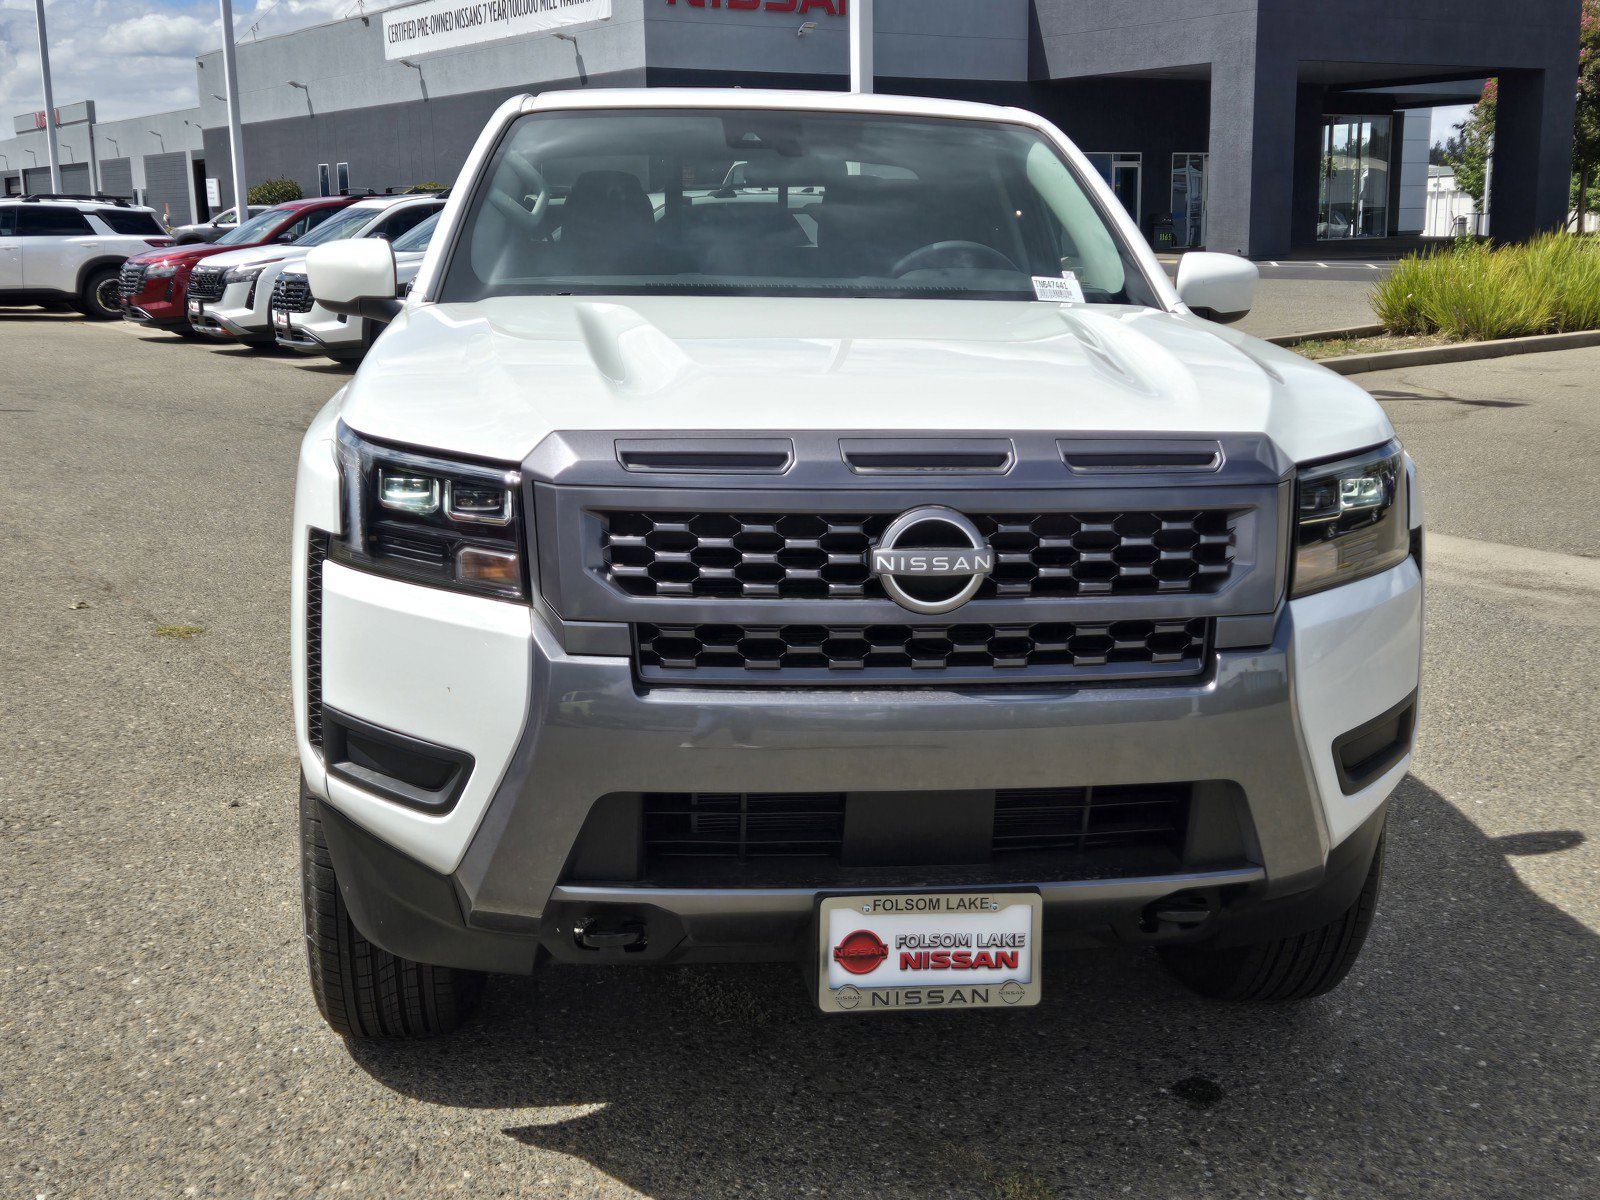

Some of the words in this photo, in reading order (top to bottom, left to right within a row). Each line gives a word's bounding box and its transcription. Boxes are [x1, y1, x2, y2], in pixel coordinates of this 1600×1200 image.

[388, 19, 417, 44] CERTIFIED
[417, 11, 454, 38] PRE-OWNED
[454, 4, 483, 30] NISSANS
[483, 3, 488, 24] 7
[876, 554, 991, 571] NISSAN
[872, 897, 941, 912] FOLSOM
[946, 897, 990, 910] LAKE
[895, 933, 973, 949] FOLSOM
[977, 932, 1026, 948] LAKE
[833, 946, 889, 958] NISSAN
[899, 951, 1019, 971] NISSAN
[872, 989, 989, 1006] NISSAN
